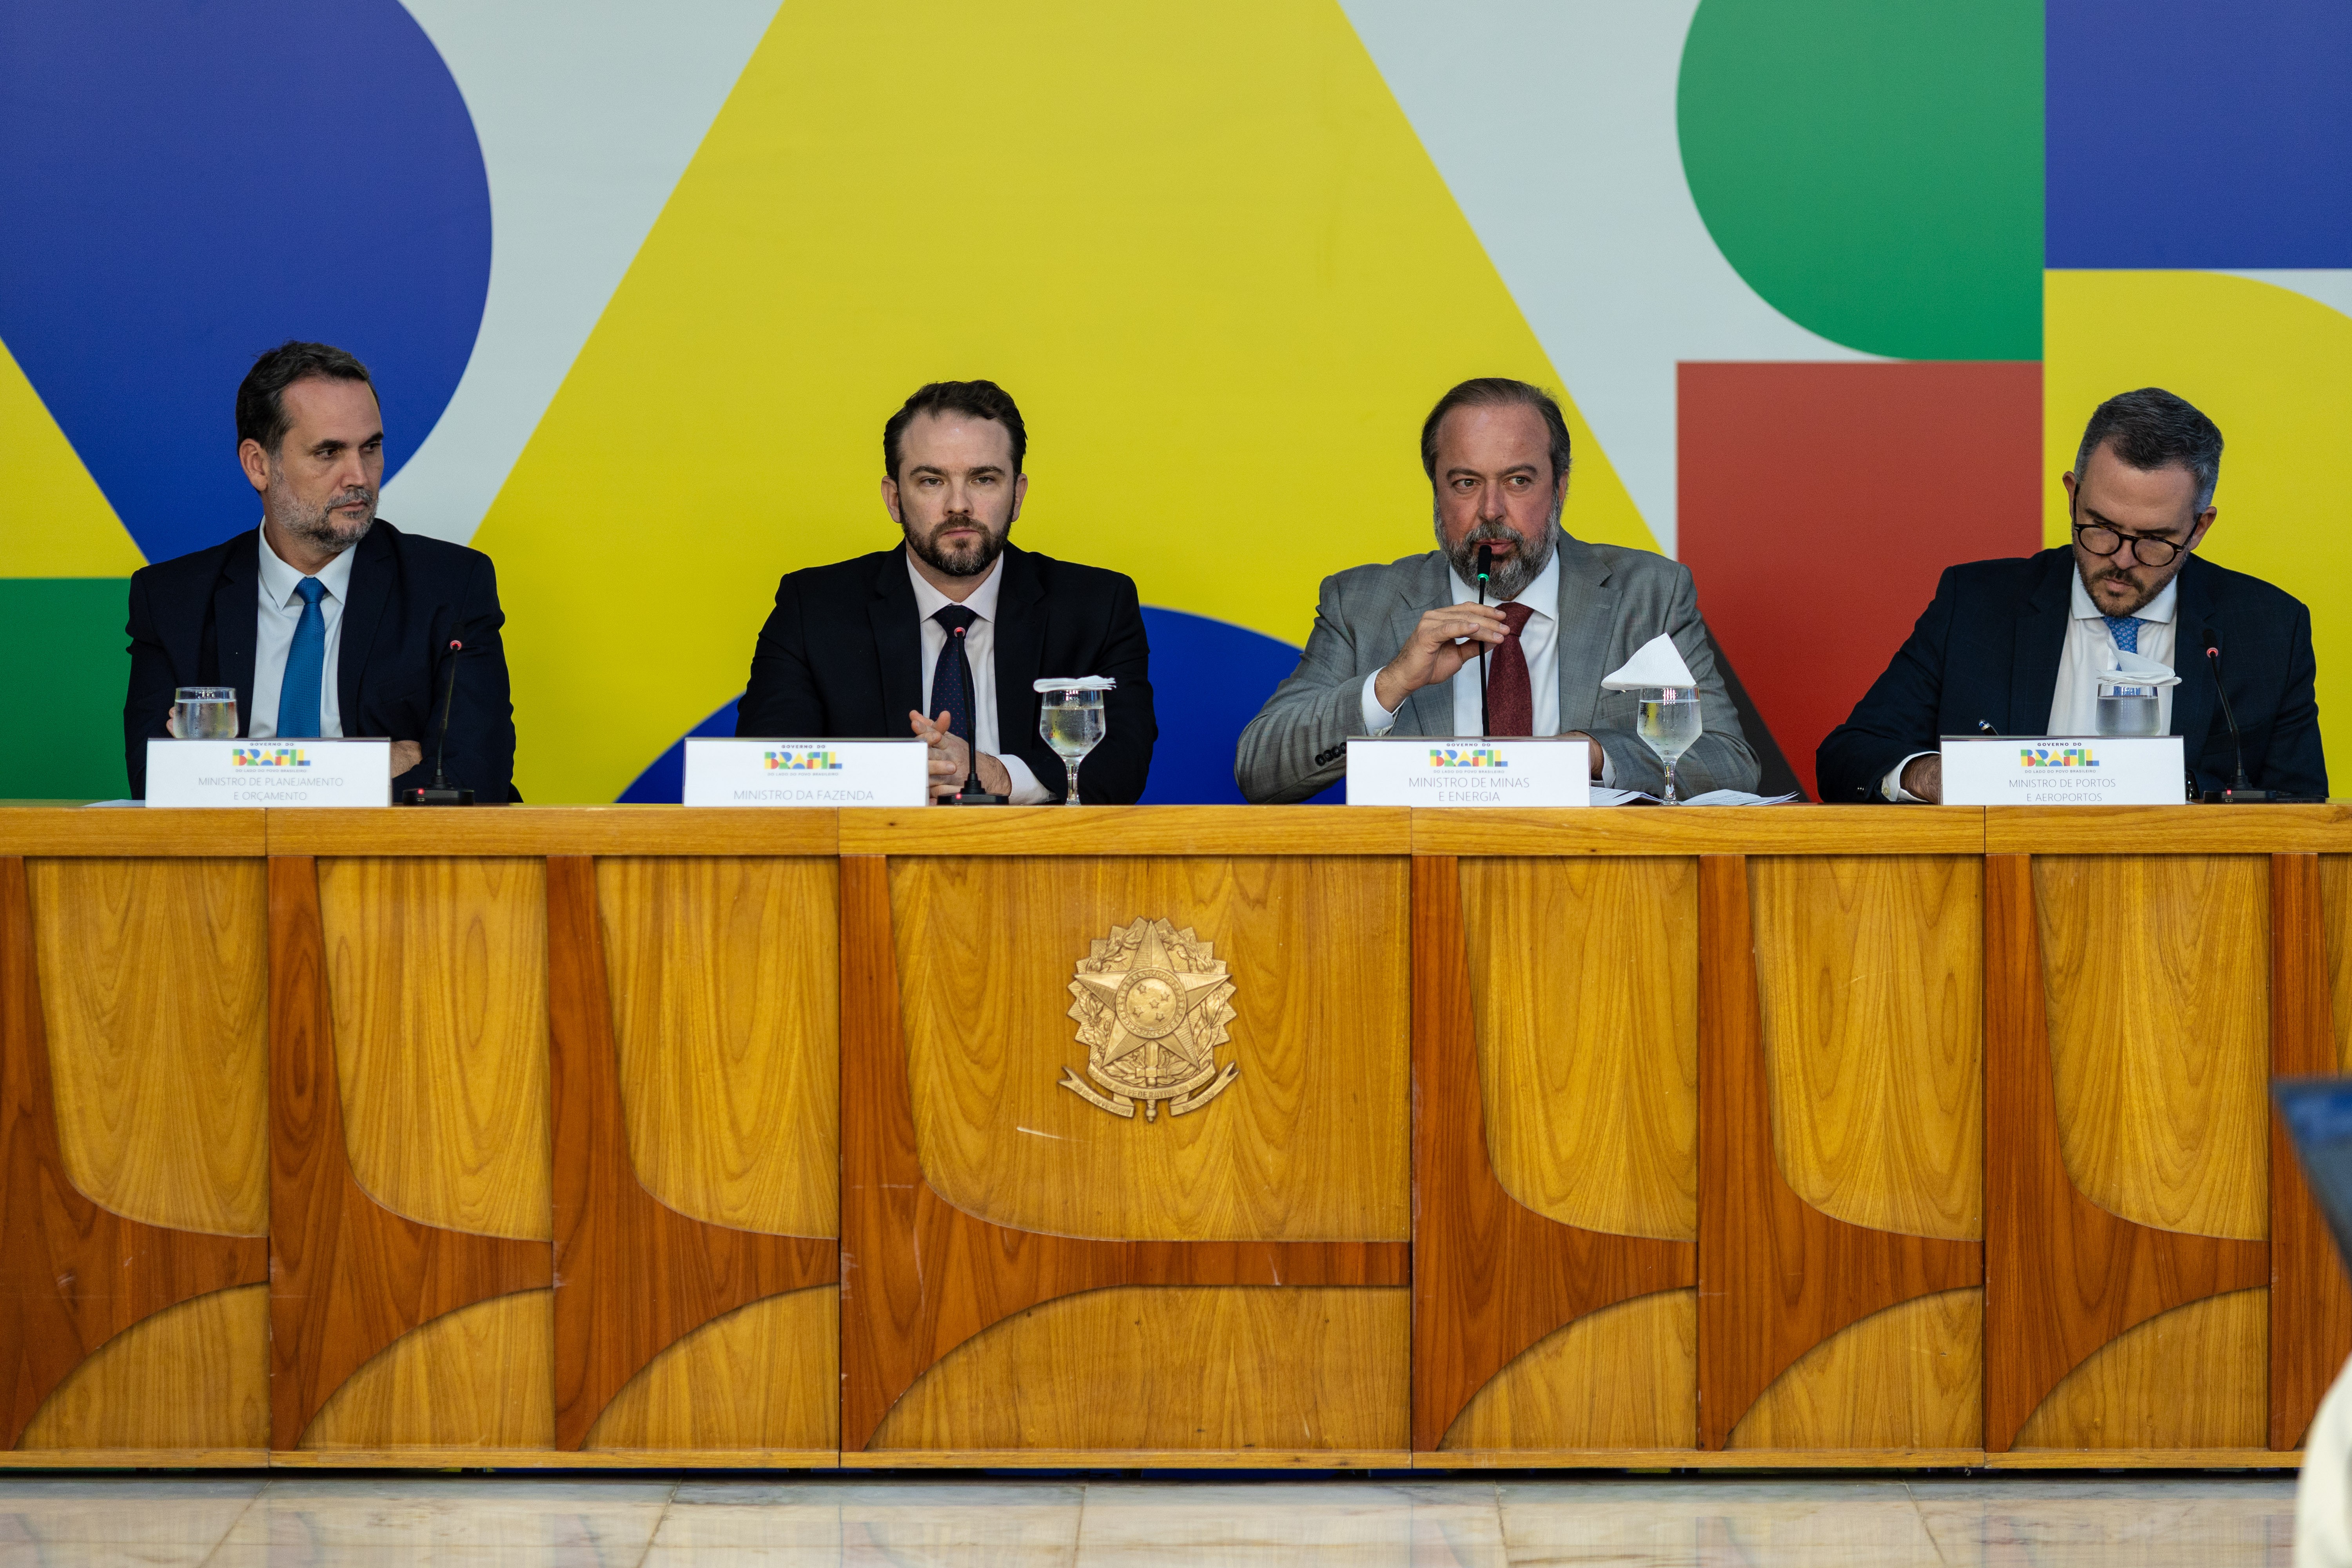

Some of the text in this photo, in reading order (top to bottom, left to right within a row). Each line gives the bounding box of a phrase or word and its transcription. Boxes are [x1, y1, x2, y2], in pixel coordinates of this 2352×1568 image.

[232, 749, 310, 766] BRASIL
[764, 752, 842, 769] BRASIL
[1430, 750, 1508, 767] BRASIL
[2021, 749, 2099, 766] BRASIL
[265, 778, 343, 786] PLANEJAMENTO
[1409, 778, 1529, 788] MINISTRO DE MINAS
[242, 792, 307, 802] ORÇAMENTO
[734, 790, 873, 800] MINISTRO DA FAZENDA
[1439, 792, 1500, 801] E ENERGIA
[1128, 1089, 1176, 1098] FEDERATIVA
[1182, 1104, 1193, 1112] DE
